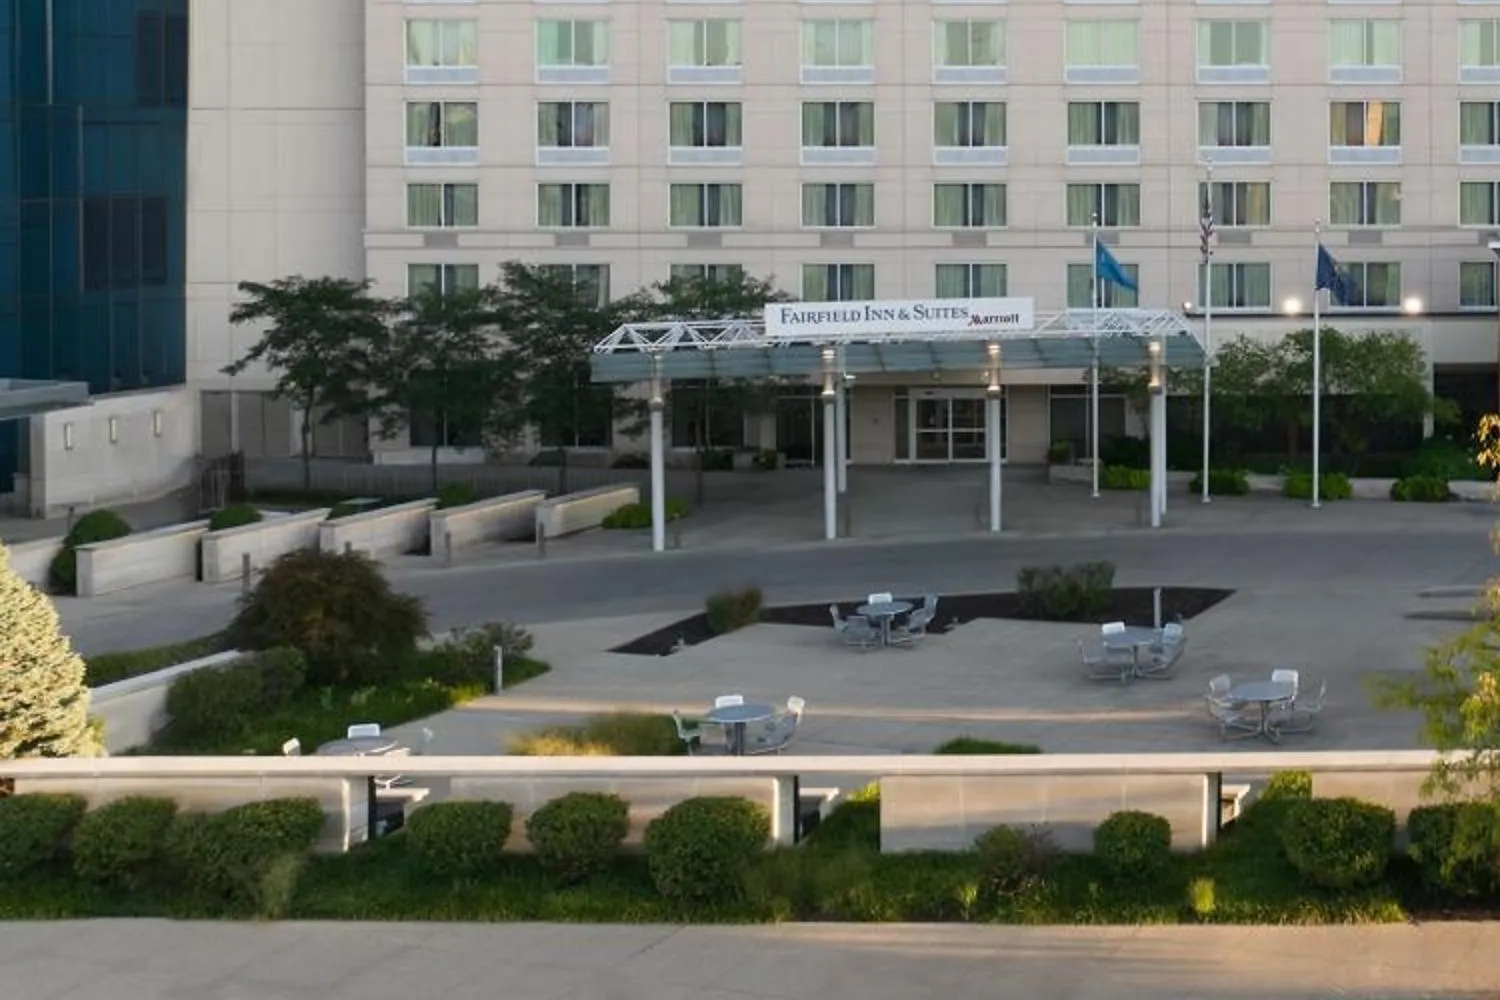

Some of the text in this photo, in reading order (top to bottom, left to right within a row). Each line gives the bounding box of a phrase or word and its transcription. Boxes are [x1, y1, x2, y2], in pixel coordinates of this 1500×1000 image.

[781, 308, 861, 324] FAIRFIELD
[865, 305, 895, 320] INN
[898, 308, 911, 321] &
[913, 304, 968, 320] SUITES
